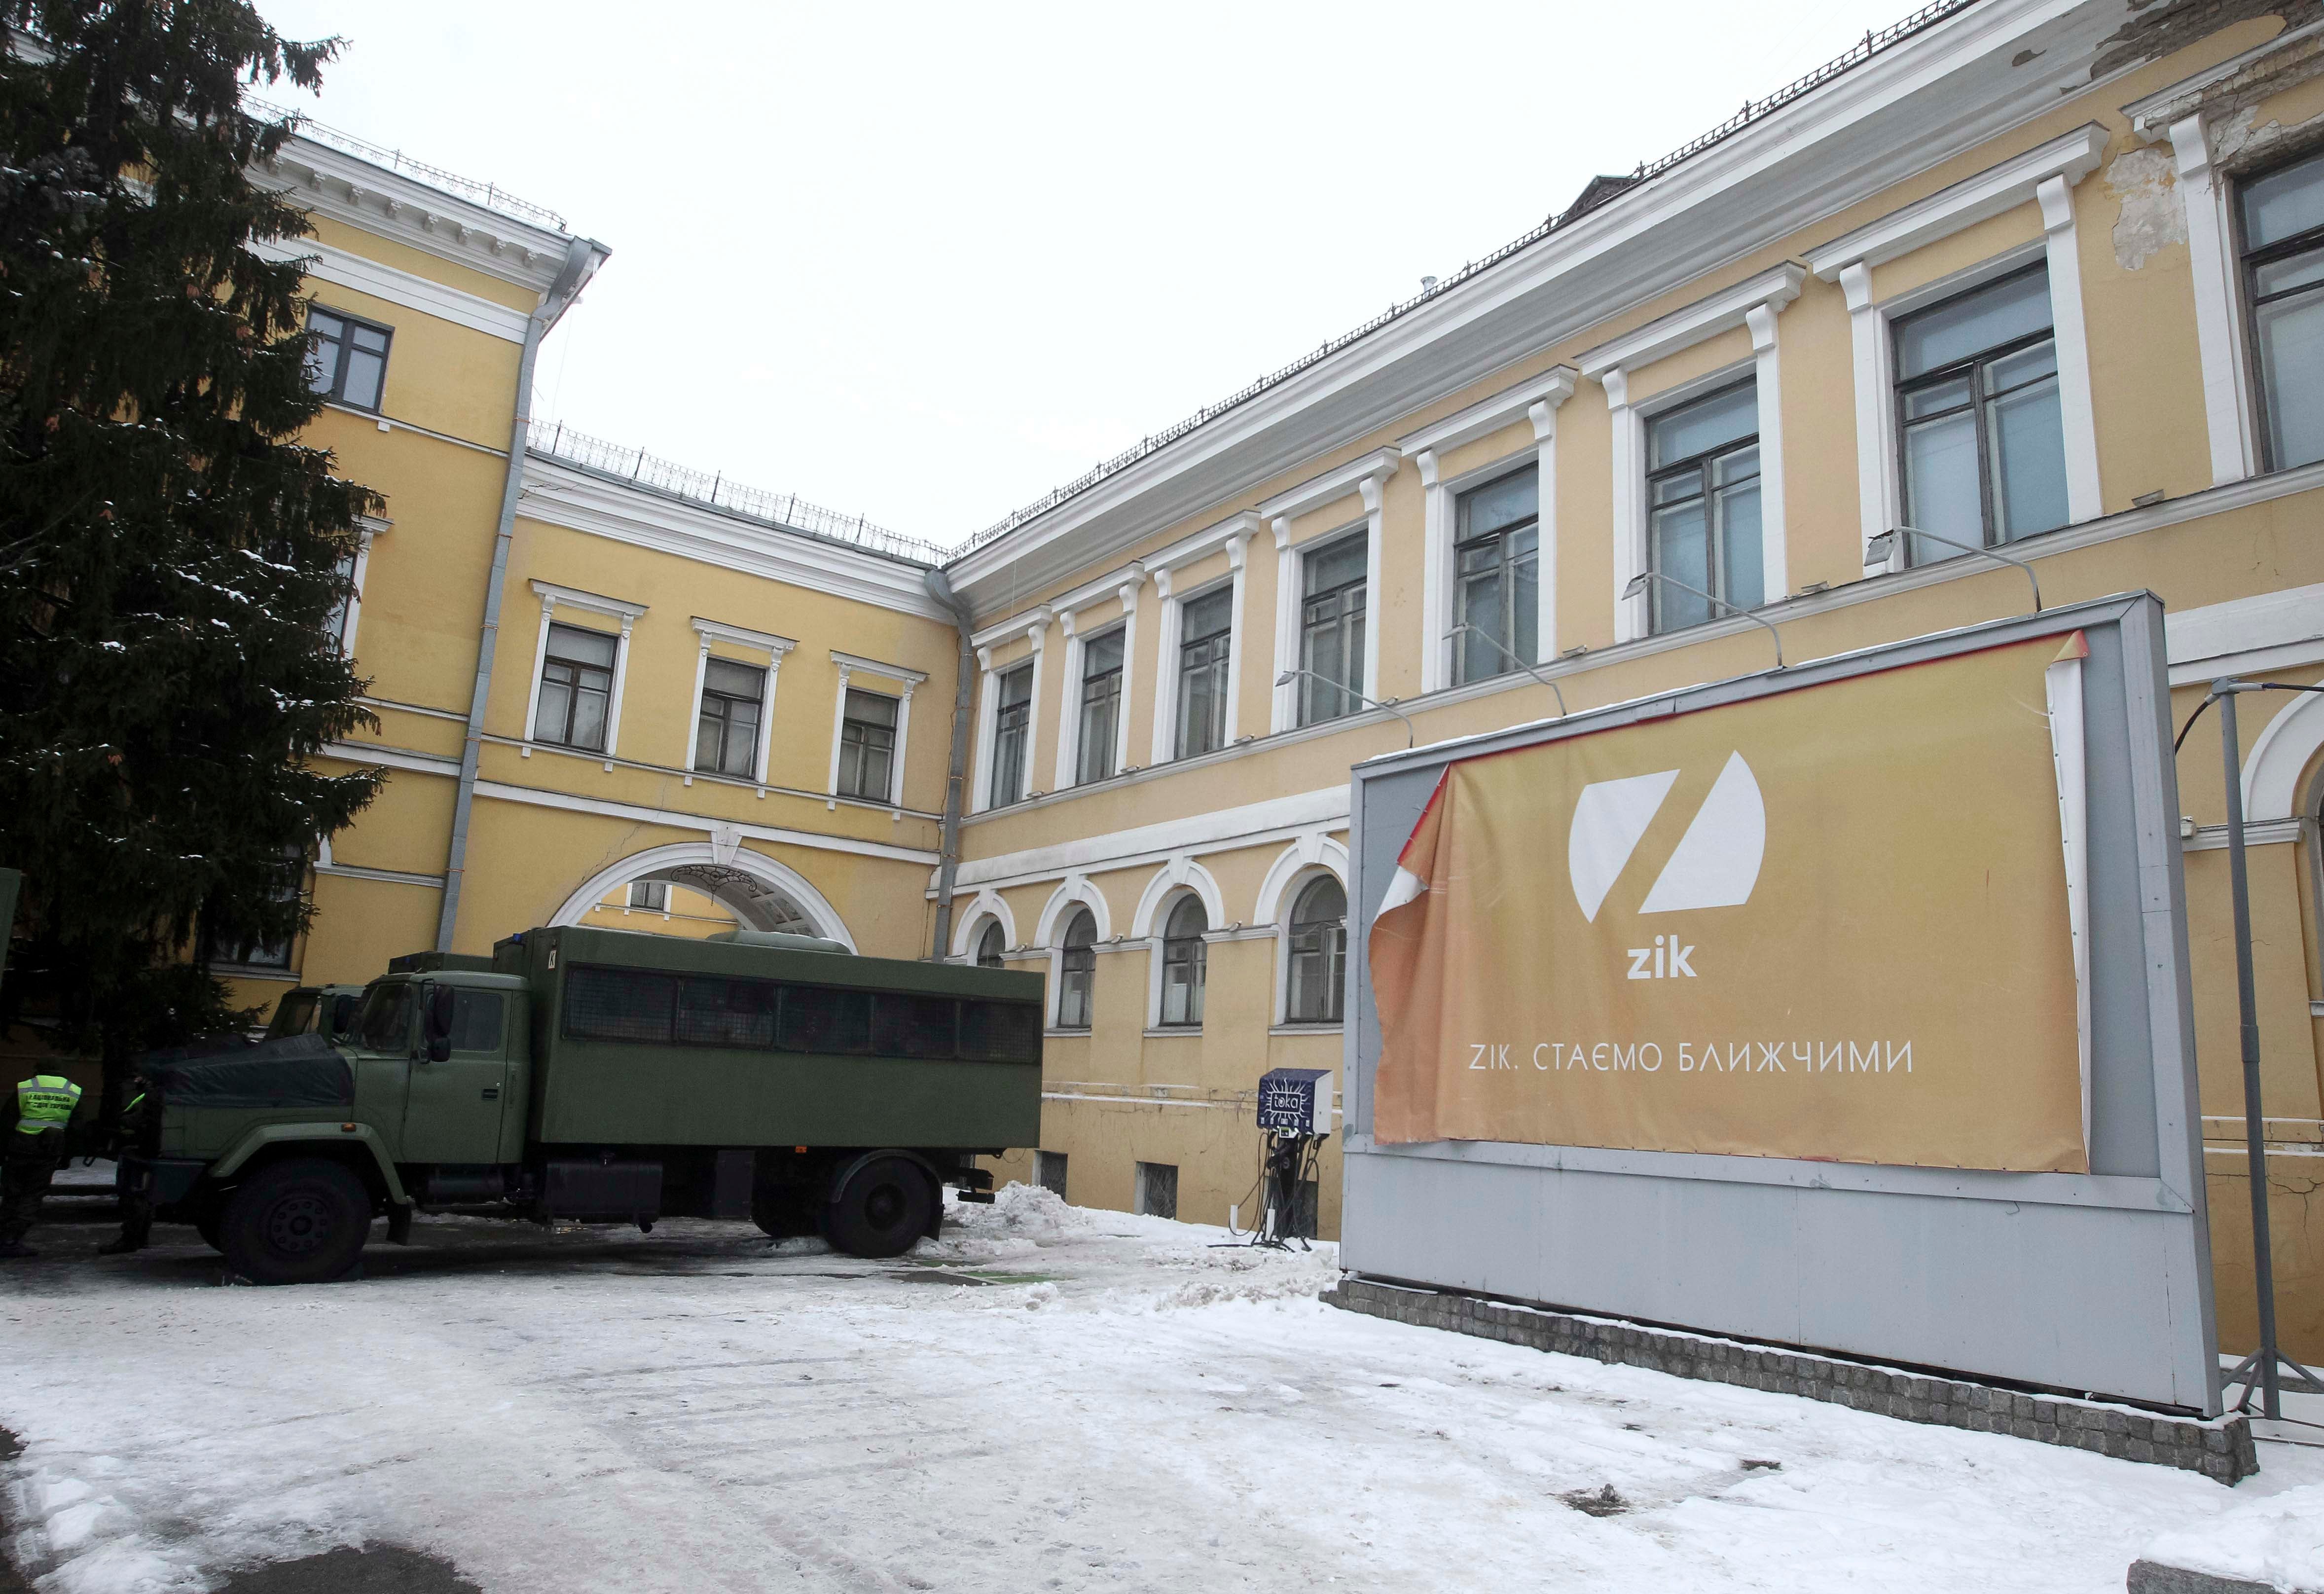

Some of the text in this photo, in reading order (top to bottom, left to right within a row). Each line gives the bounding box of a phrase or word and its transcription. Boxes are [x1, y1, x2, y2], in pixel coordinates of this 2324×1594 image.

[1627, 934, 1697, 979] zik
[1469, 1041, 1913, 1074] ZIK. СТАЄМО БЛИЖЧИМИ
[1274, 1093, 1298, 1109] toka
